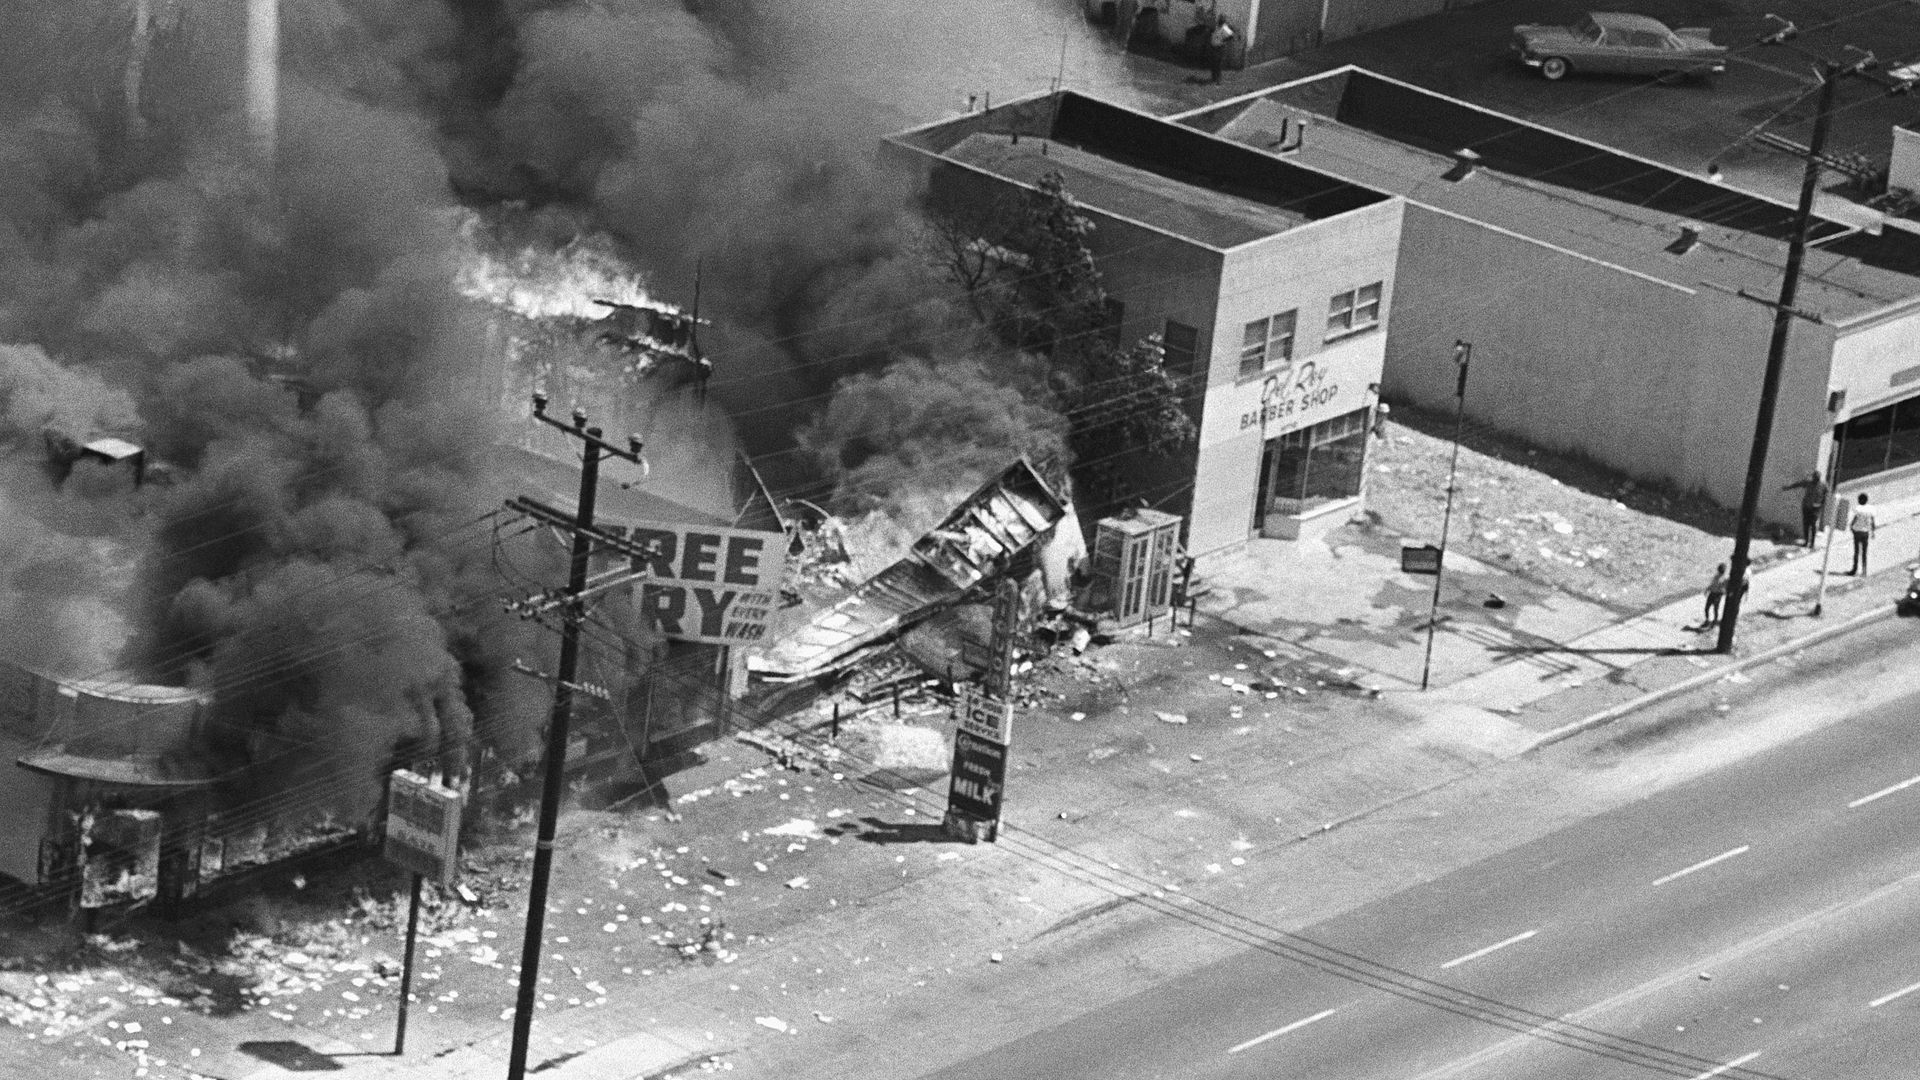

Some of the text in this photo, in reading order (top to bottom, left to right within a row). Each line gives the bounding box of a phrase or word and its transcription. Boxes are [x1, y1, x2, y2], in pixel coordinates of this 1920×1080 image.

[1240, 399, 1295, 430] BABER
[1300, 384, 1338, 411] SHOP
[597, 583, 737, 637] RY
[966, 704, 999, 729] ICE
[955, 776, 993, 806] MILK
